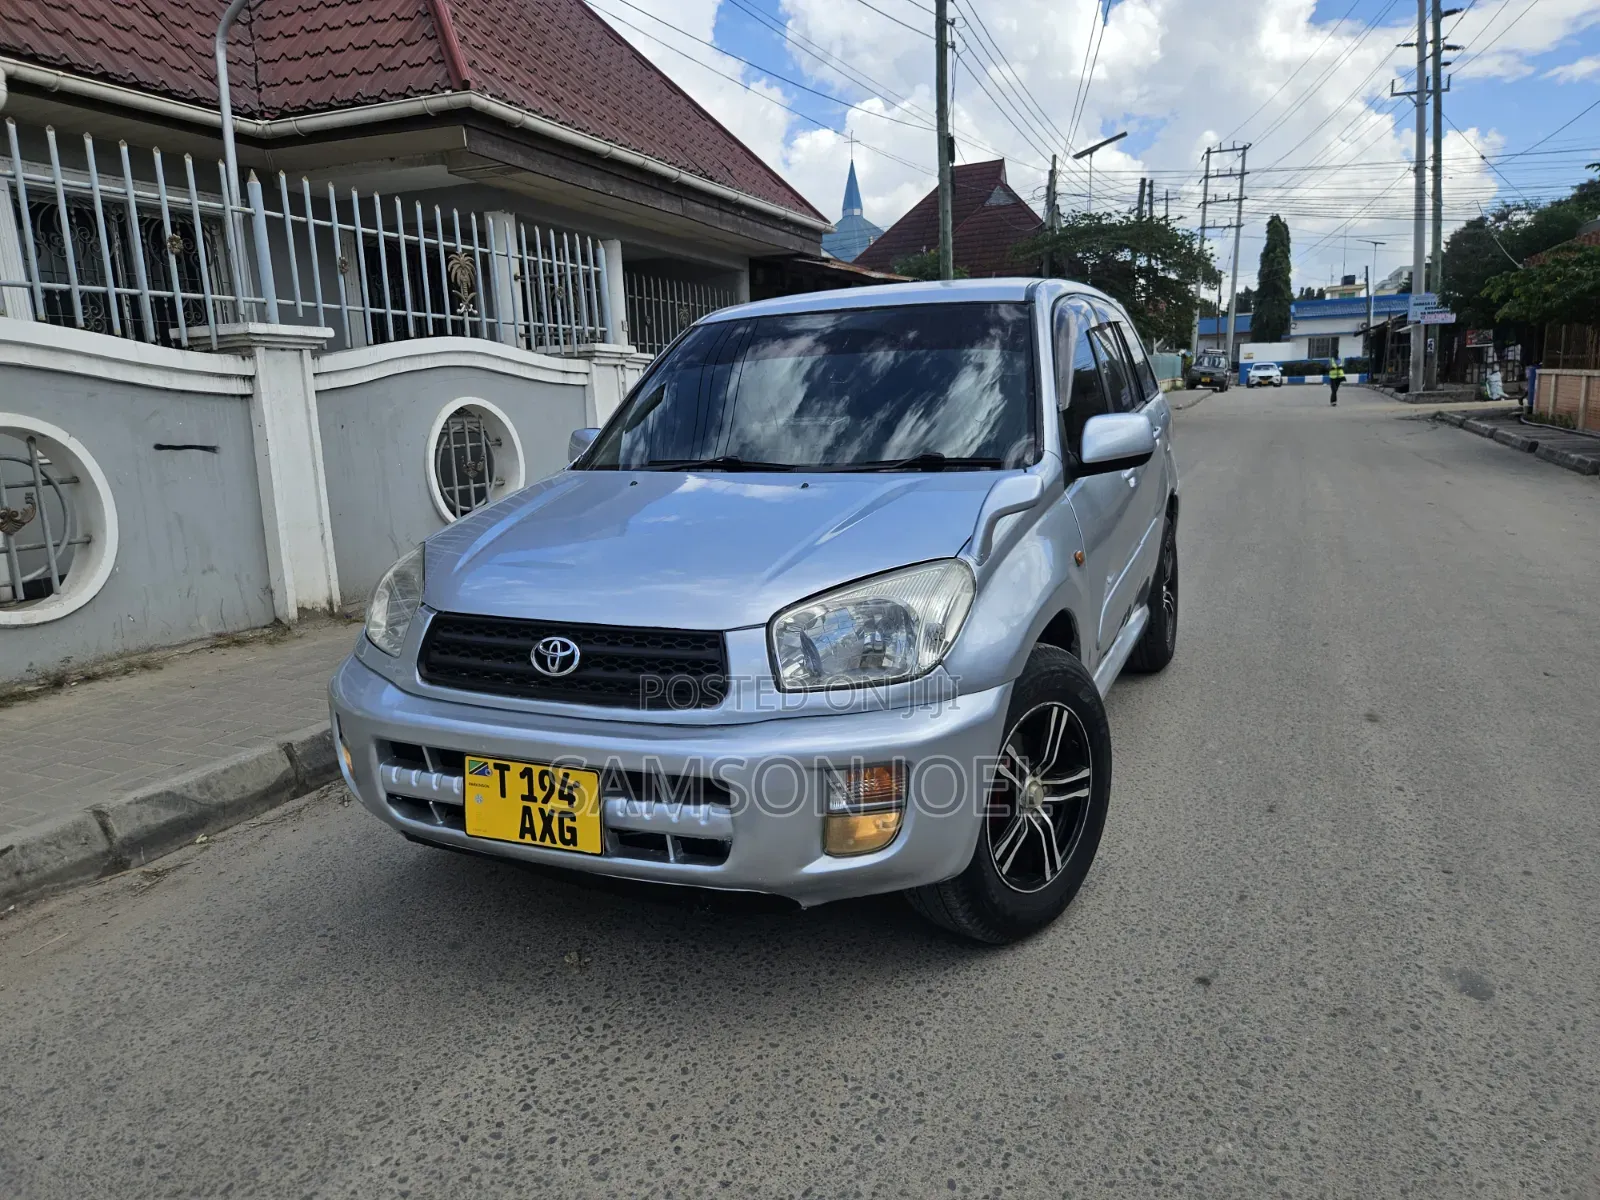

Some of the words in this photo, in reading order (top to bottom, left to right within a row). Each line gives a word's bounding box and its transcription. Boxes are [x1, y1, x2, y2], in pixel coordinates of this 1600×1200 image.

[493, 762, 511, 799] T
[519, 766, 577, 808] 194
[519, 805, 578, 847] AXG
